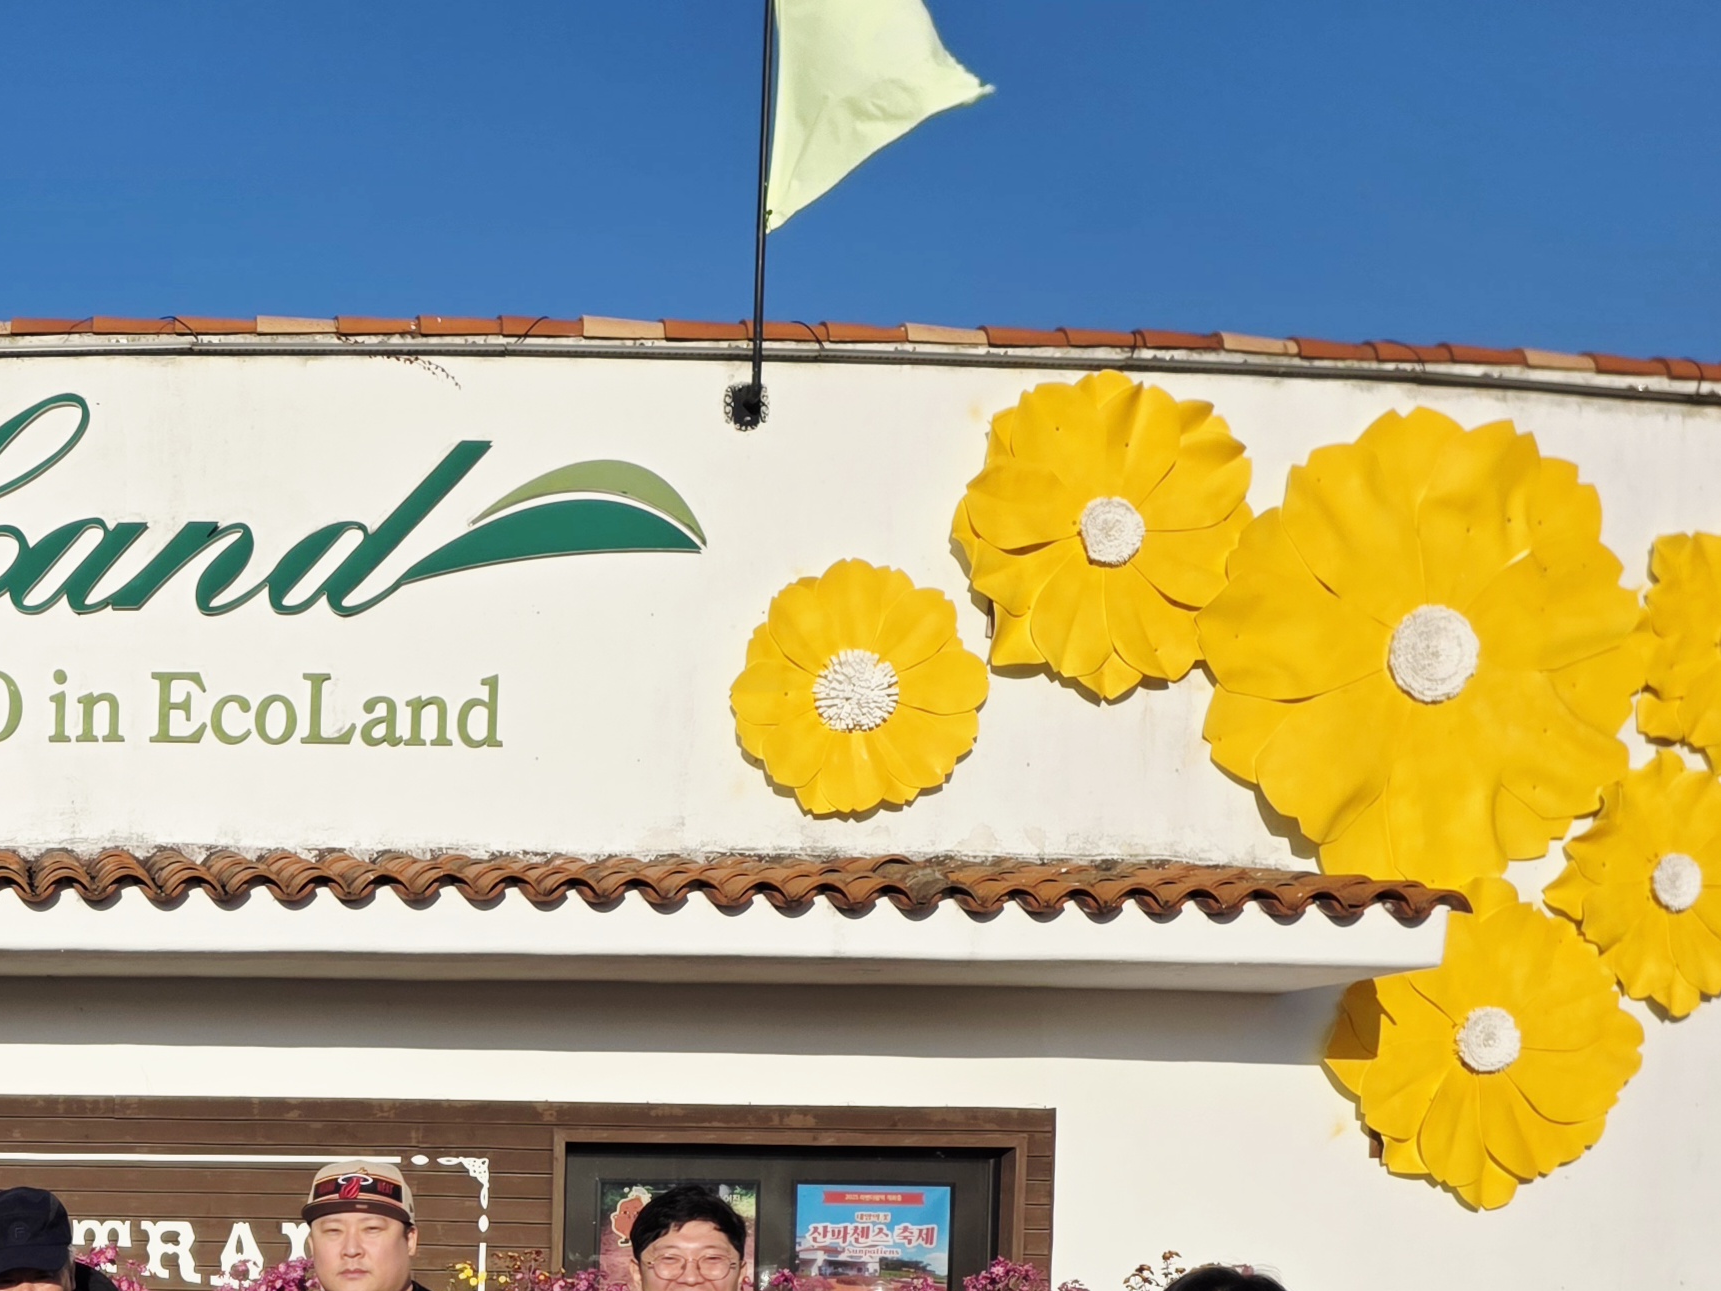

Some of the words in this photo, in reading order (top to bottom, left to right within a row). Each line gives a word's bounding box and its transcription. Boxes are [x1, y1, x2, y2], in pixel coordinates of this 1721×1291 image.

[47, 669, 122, 744] in
[149, 670, 503, 750] EcoLand
[72, 1219, 313, 1291] TRA
[808, 1224, 892, 1245] 산파첸스
[895, 1225, 936, 1246] 축제
